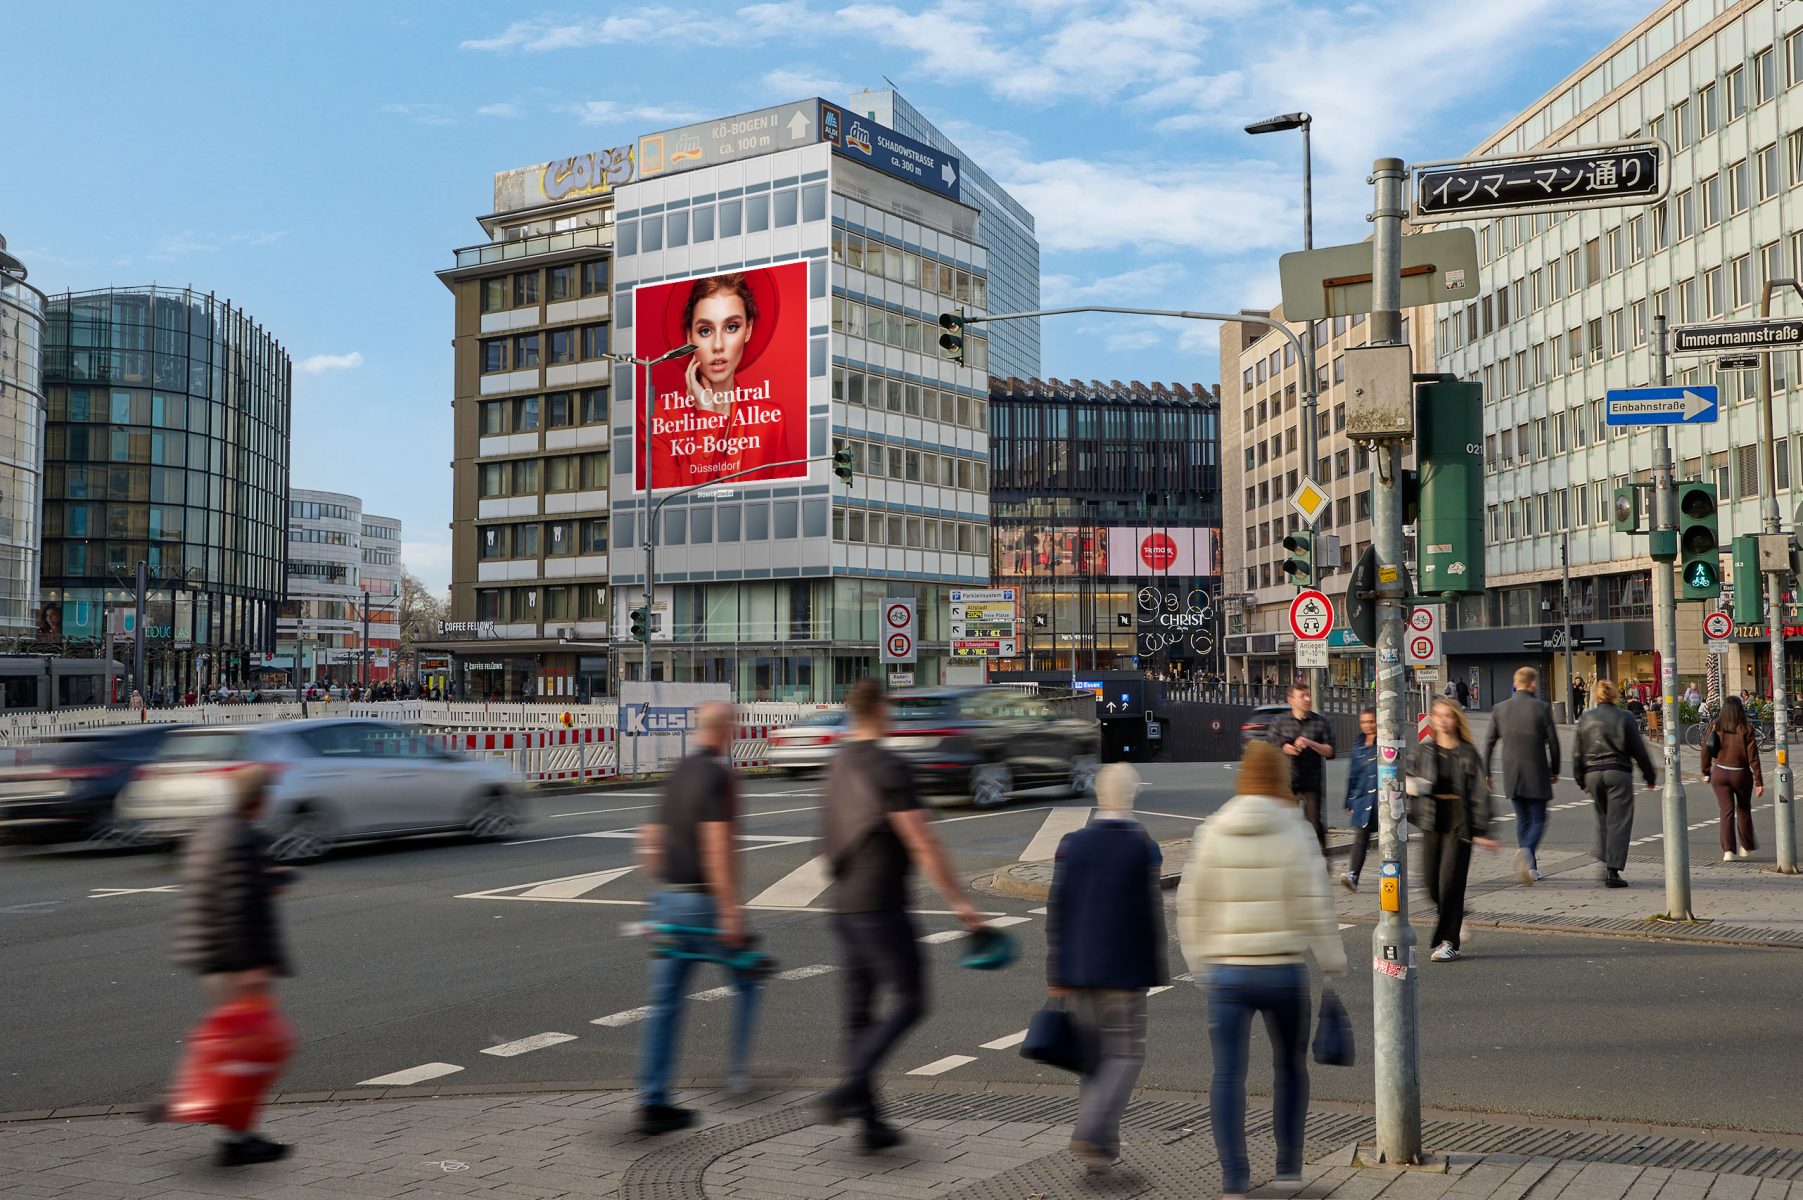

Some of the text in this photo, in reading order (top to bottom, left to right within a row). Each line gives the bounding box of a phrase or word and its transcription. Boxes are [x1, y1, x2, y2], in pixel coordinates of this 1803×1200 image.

[712, 114, 778, 139] KÖ-BOGEN II
[824, 126, 838, 136] ALDI
[849, 120, 870, 144] dm
[719, 136, 770, 155] ca. 100 m
[878, 135, 935, 168] SCHADOWSTRASSE
[543, 144, 635, 200] COPS
[891, 157, 922, 176] ca. 300 m
[1433, 157, 1641, 204] インマーマン通り
[1682, 326, 1799, 347] Immermannstraße
[661, 380, 770, 411] The Central
[1612, 402, 1686, 412] Einbahnstraße
[652, 406, 782, 435] Berliner Allee
[670, 434, 760, 457] Kö-Bogen
[689, 460, 741, 474] Düsseldorf
[444, 621, 467, 632] COFFEE
[467, 621, 494, 631] FELLOWS
[1160, 613, 1203, 626] CHRIST
[1734, 626, 1760, 637] PIZZA
[469, 662, 503, 670] COFFEE FELLOWS
